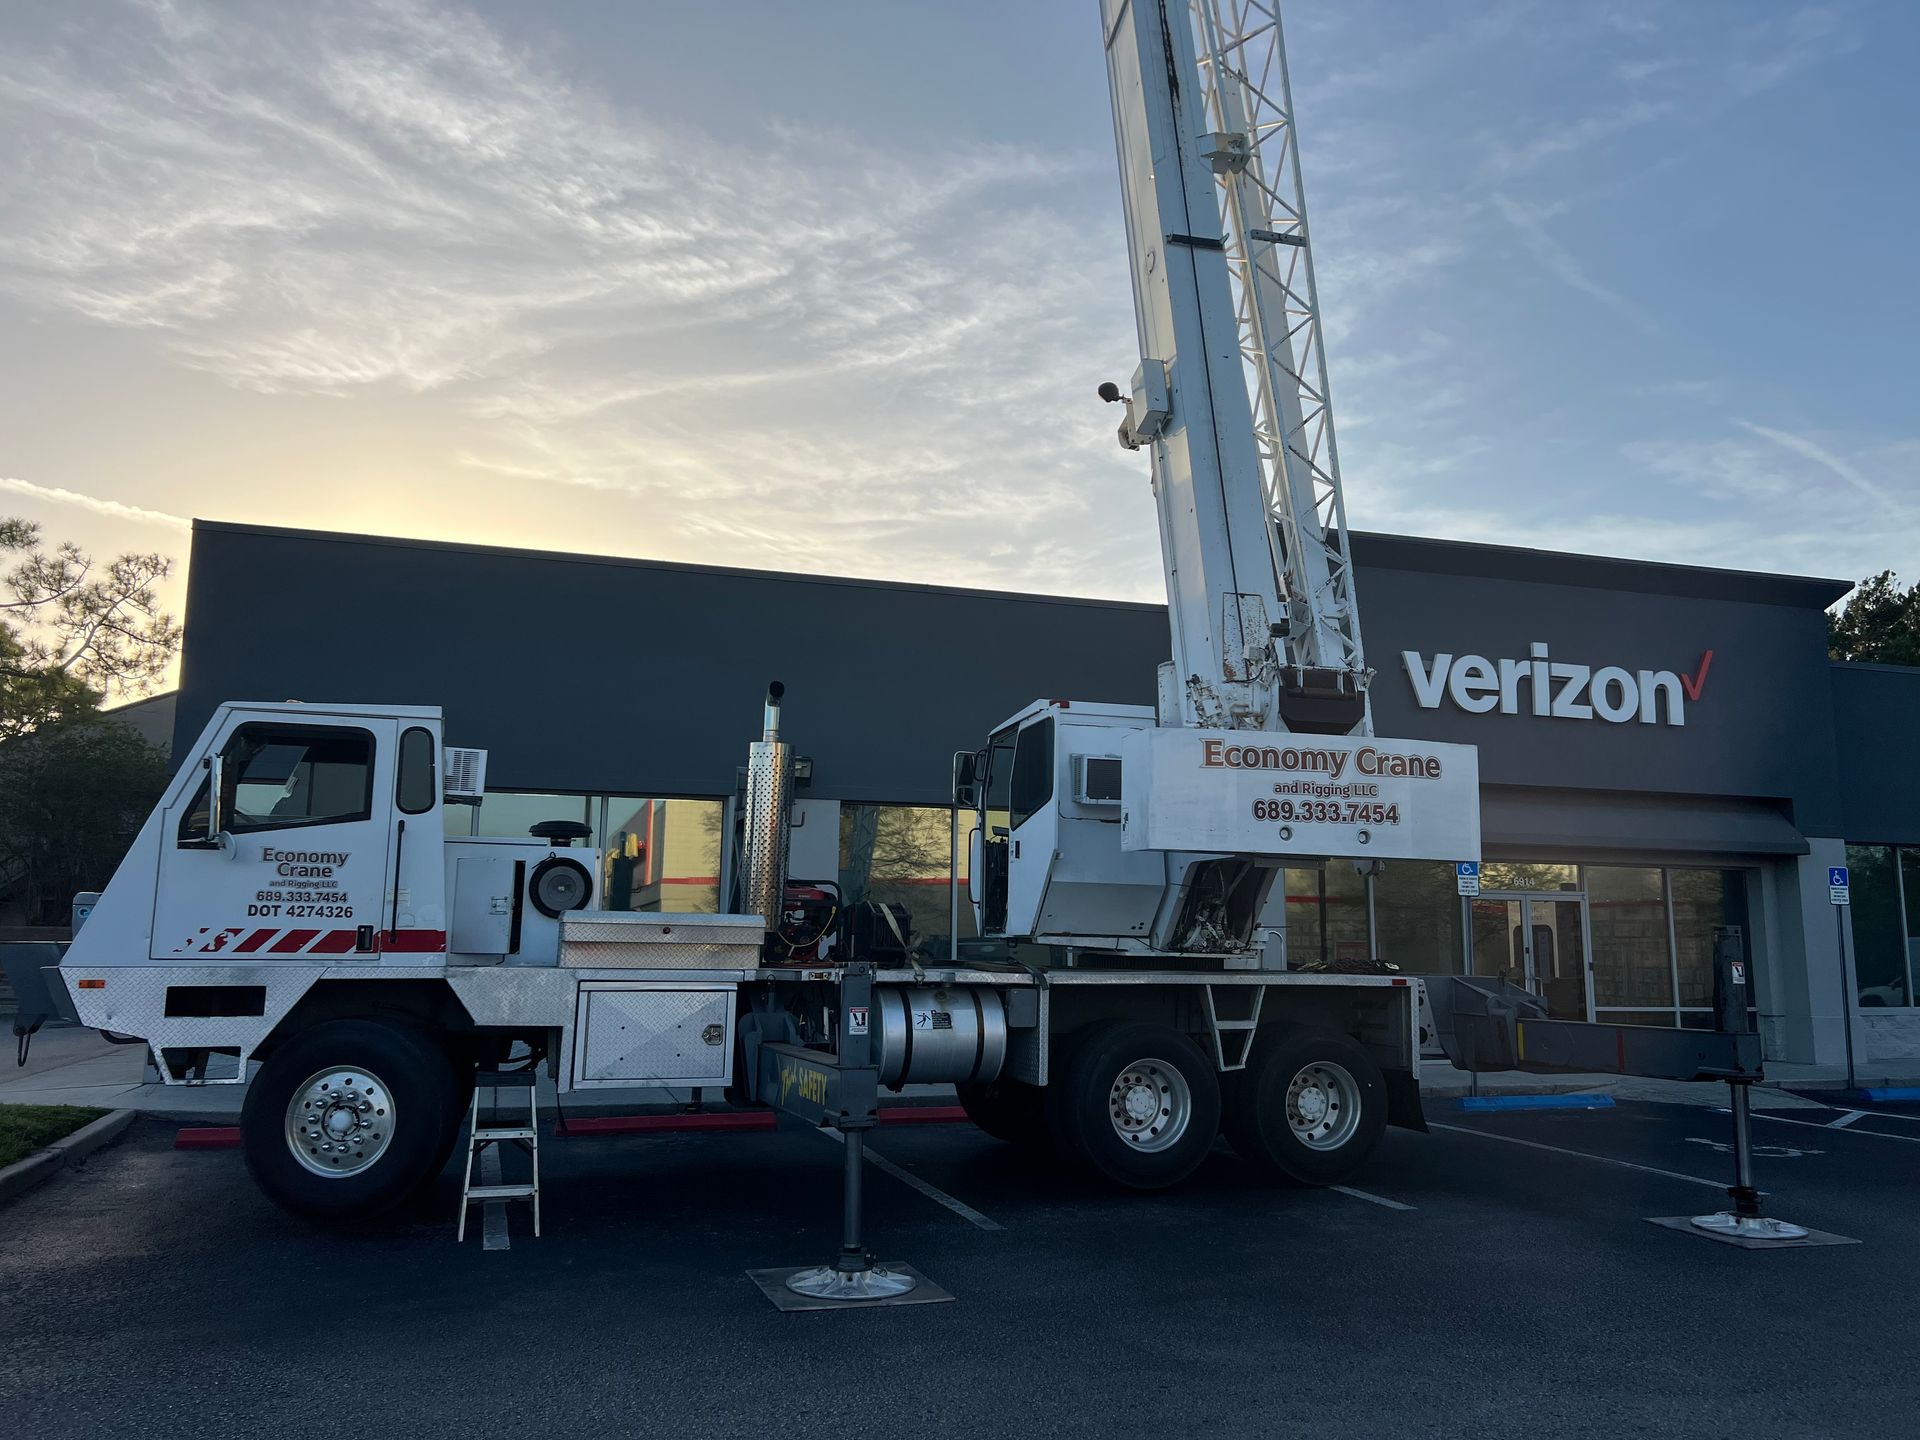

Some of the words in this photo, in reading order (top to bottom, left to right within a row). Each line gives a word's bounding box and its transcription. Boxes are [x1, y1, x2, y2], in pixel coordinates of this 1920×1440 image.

[1402, 641, 1685, 726] verizon
[1203, 740, 1350, 779] Economy
[1355, 746, 1441, 779] Crane
[1274, 782, 1299, 795] and
[1301, 782, 1351, 798] Rigging
[1353, 784, 1379, 797] LLC
[1252, 799, 1400, 824] 689.333.7454
[261, 847, 350, 868] Economy
[277, 862, 333, 878] Crane
[269, 880, 286, 888] and
[287, 880, 320, 890] Rigging
[321, 881, 339, 889] LLC
[256, 890, 348, 903] 689.333.7454
[247, 904, 282, 917] DOT
[286, 905, 353, 918] 4274326
[798, 1066, 828, 1106] SAFETY
